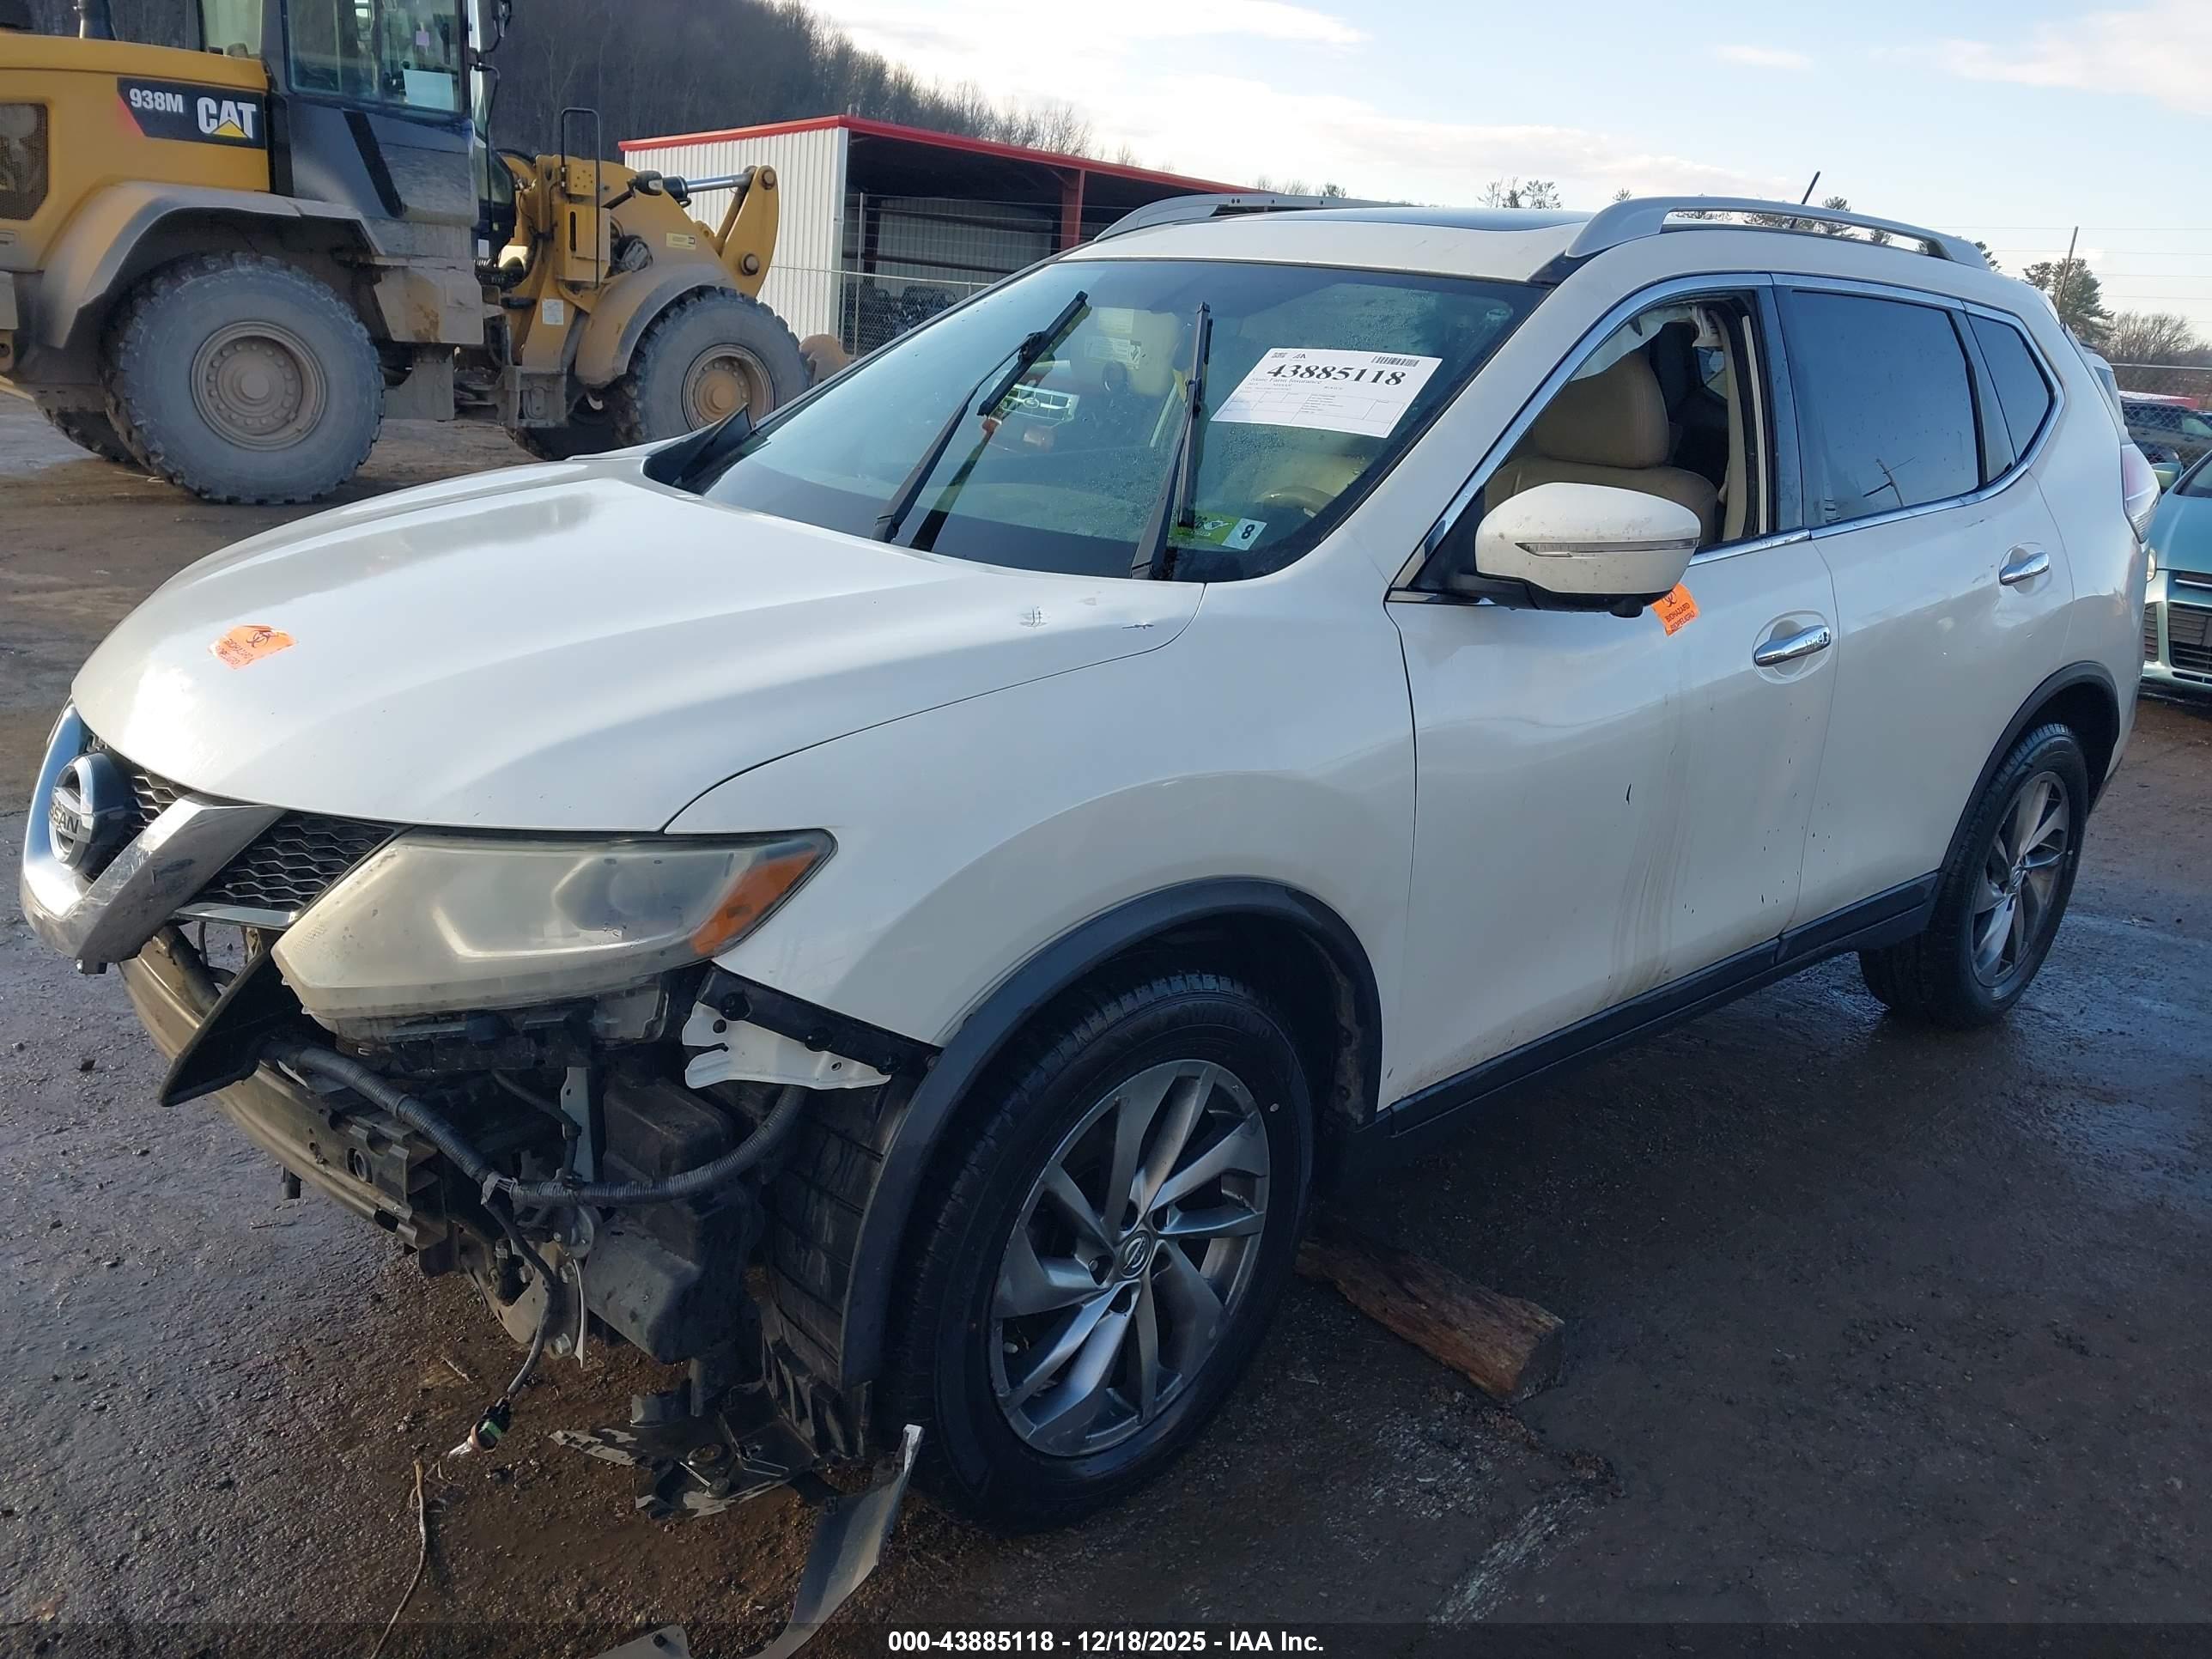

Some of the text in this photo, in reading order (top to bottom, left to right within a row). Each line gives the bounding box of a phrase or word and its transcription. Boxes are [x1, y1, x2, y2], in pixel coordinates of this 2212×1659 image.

[129, 88, 184, 113] 938M
[197, 97, 257, 139] CAT
[1267, 363, 1407, 386] 43885118
[1241, 524, 1255, 539] 8
